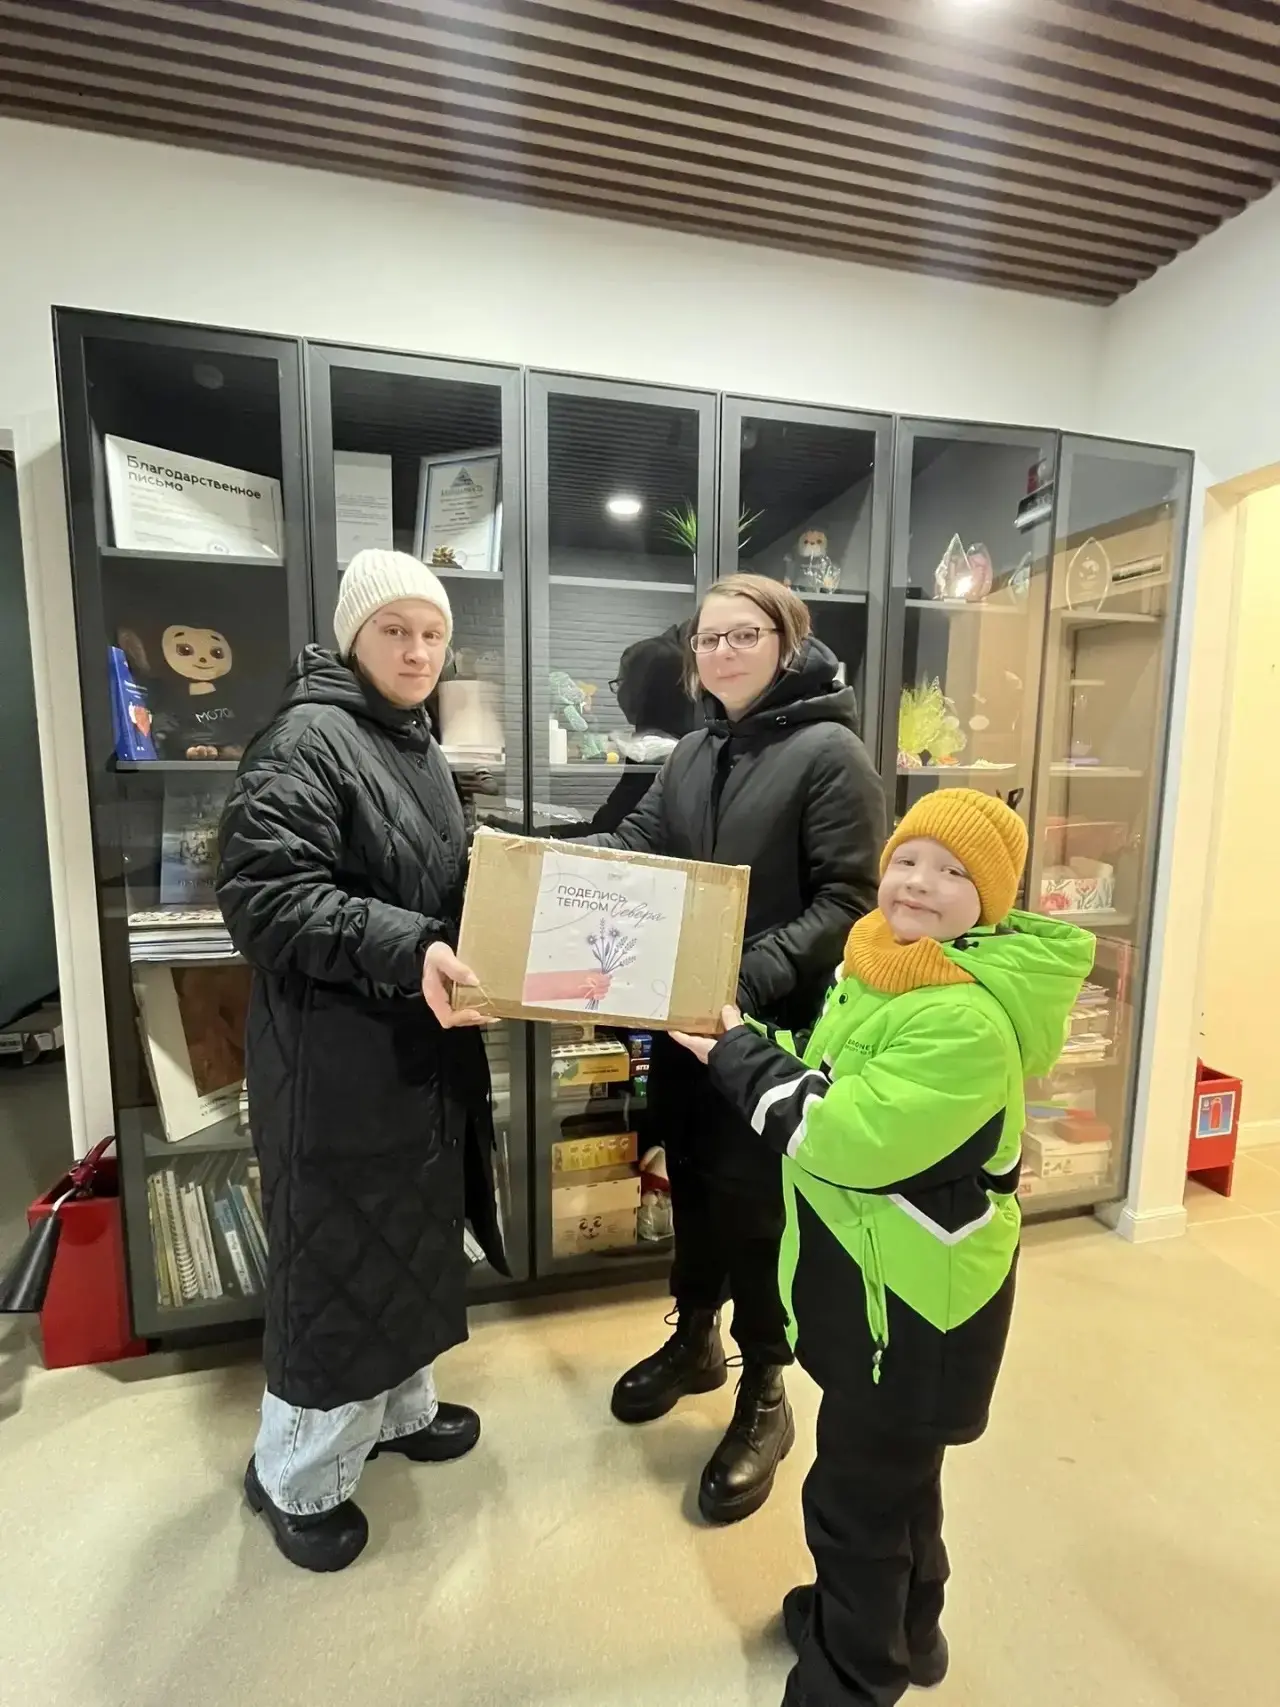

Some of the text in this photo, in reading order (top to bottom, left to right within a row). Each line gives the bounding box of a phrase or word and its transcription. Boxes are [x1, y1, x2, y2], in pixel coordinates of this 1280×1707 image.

[126, 454, 262, 500] Благодарственное
[128, 471, 184, 492] письмо
[556, 885, 628, 902] ПОДЕЛИСЬ
[556, 896, 667, 928] ТЕПЛОМ Севера
